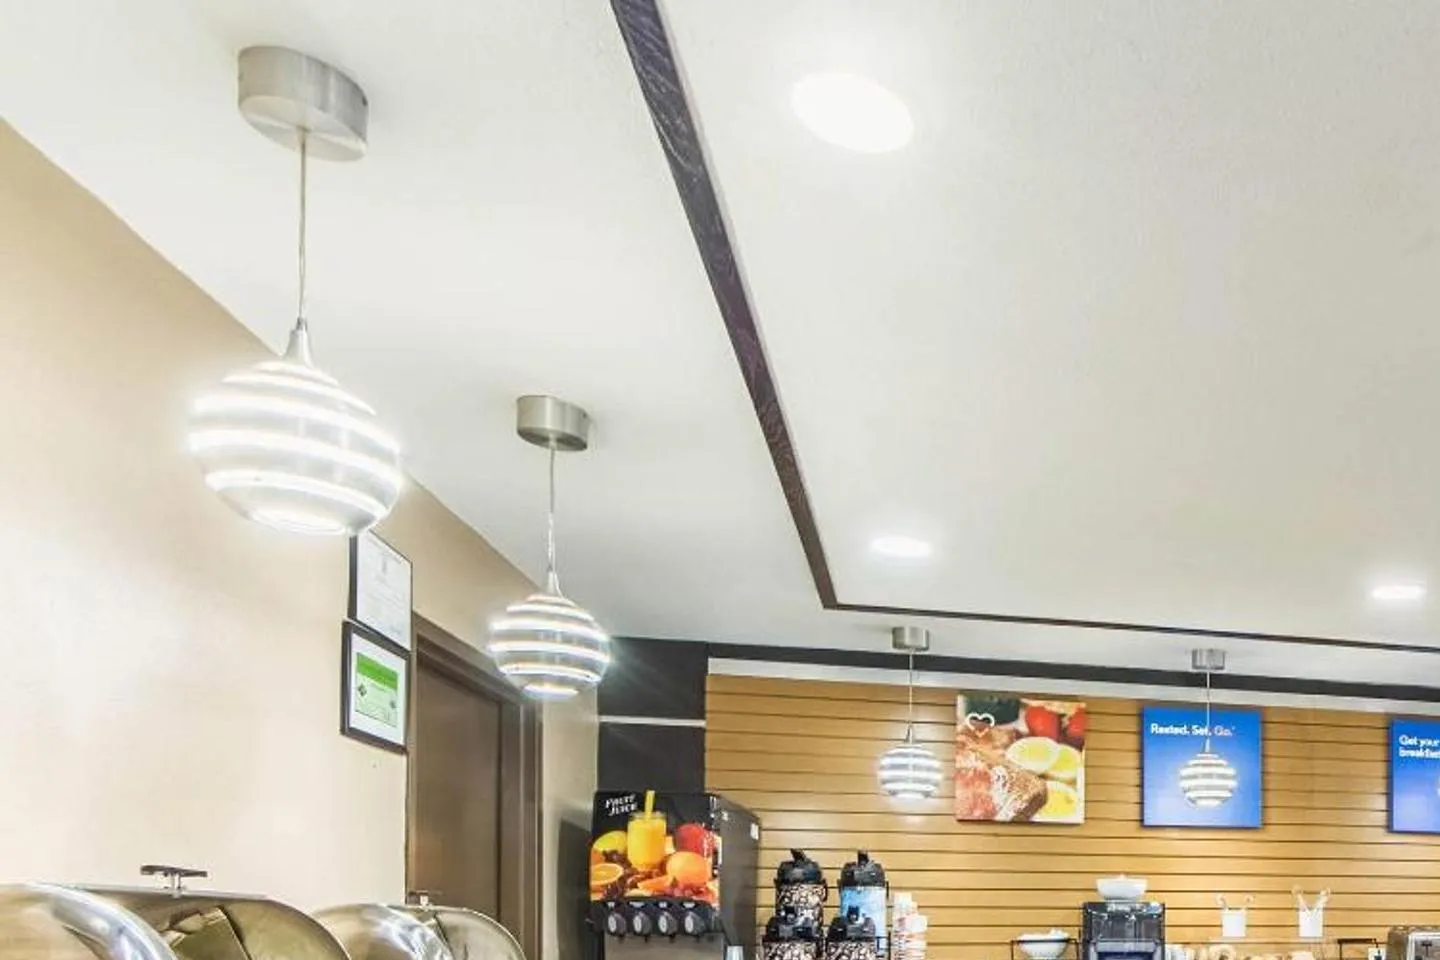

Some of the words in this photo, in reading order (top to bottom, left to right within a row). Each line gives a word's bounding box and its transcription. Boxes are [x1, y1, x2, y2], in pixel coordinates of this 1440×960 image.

[1150, 722, 1190, 736] Rested.
[1191, 724, 1212, 737] Set.
[1399, 734, 1418, 746] Get
[1418, 738, 1440, 748] your
